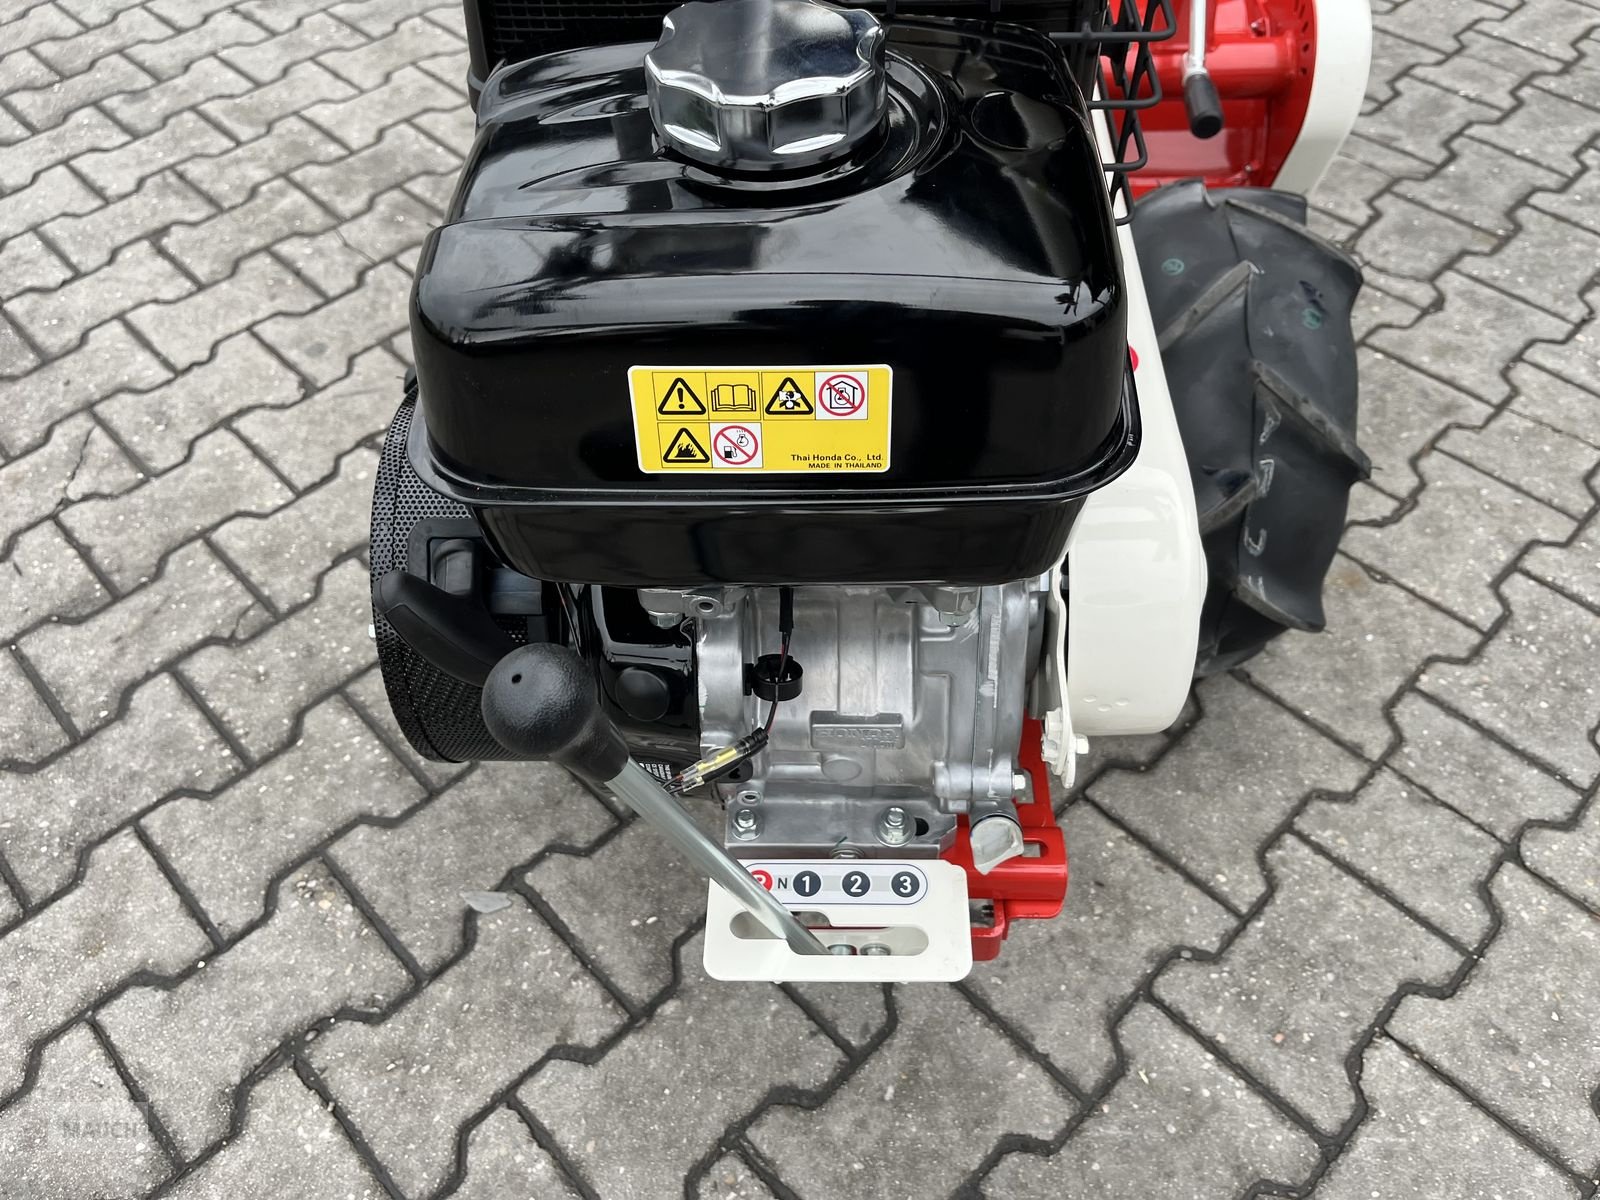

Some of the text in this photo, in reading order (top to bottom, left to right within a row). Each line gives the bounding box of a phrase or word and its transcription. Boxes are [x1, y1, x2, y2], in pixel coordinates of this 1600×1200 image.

[844, 454, 861, 462] Co.,
[777, 877, 788, 889] N
[802, 875, 811, 893] 1
[850, 875, 863, 893] 2
[899, 876, 912, 893] 3
